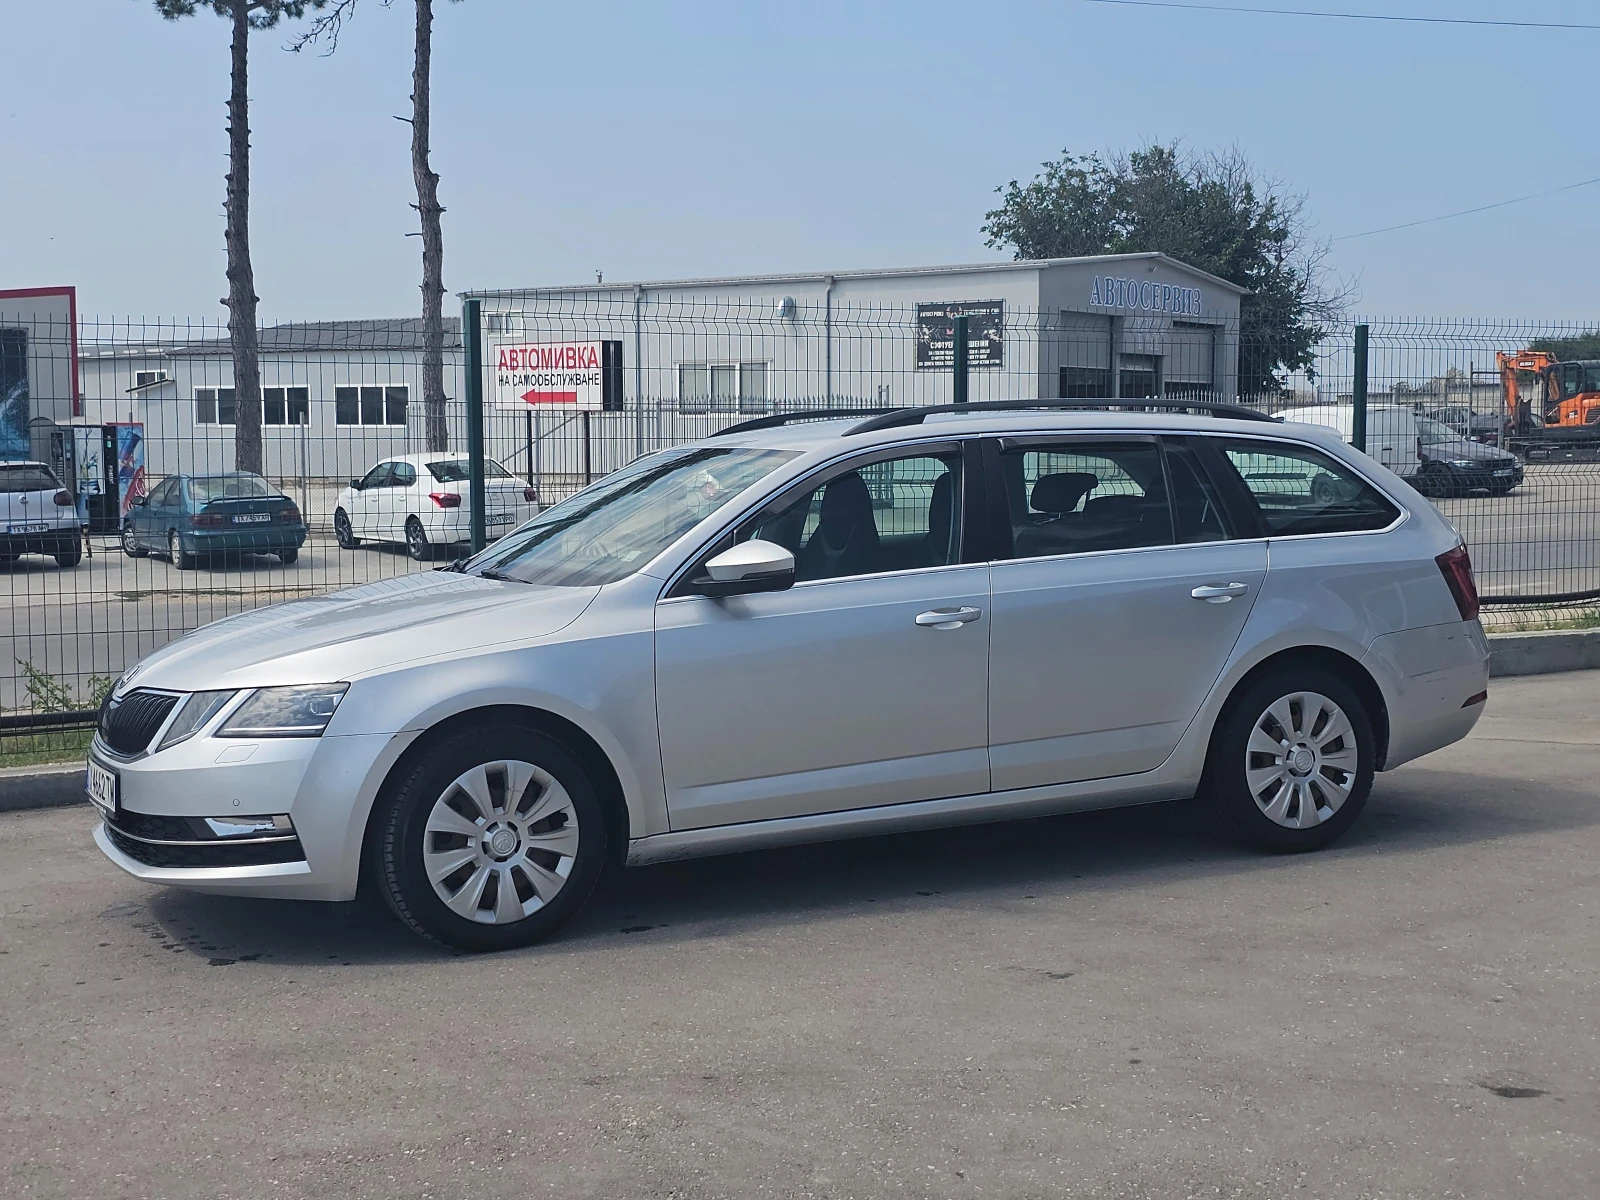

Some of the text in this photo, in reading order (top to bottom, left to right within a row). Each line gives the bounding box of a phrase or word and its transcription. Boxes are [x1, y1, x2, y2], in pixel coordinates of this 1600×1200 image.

[1090, 275, 1201, 316] АВТОСЕРВИЗ
[498, 346, 599, 371] АВТОМИВКА
[498, 373, 600, 387] НА САМООБСЛУЖВАНЕ
